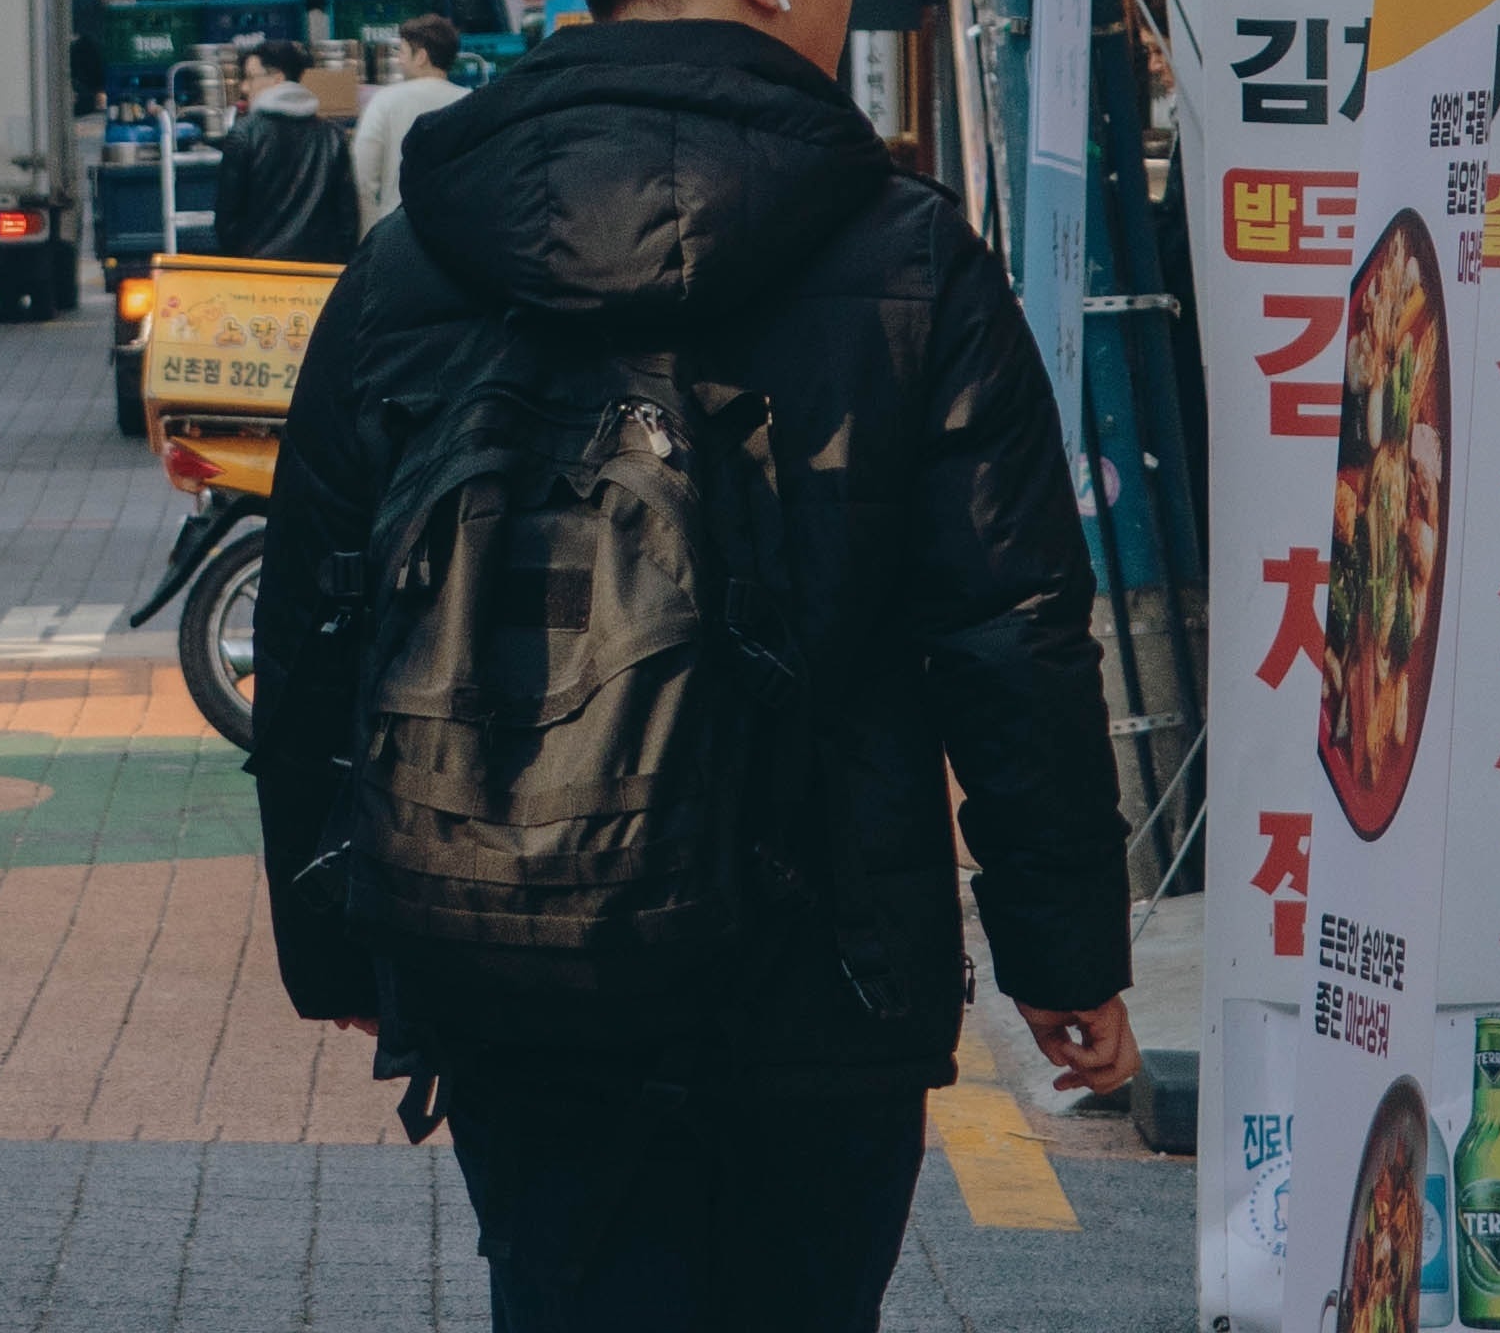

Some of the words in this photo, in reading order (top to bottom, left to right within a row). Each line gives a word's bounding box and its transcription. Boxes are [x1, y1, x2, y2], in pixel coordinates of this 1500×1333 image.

[1233, 181, 1359, 253] 밥도
[162, 356, 221, 386] 신촌점
[1319, 912, 1360, 976] 든든한
[1360, 924, 1406, 992] 술안주로
[1314, 980, 1344, 1041] 좋은
